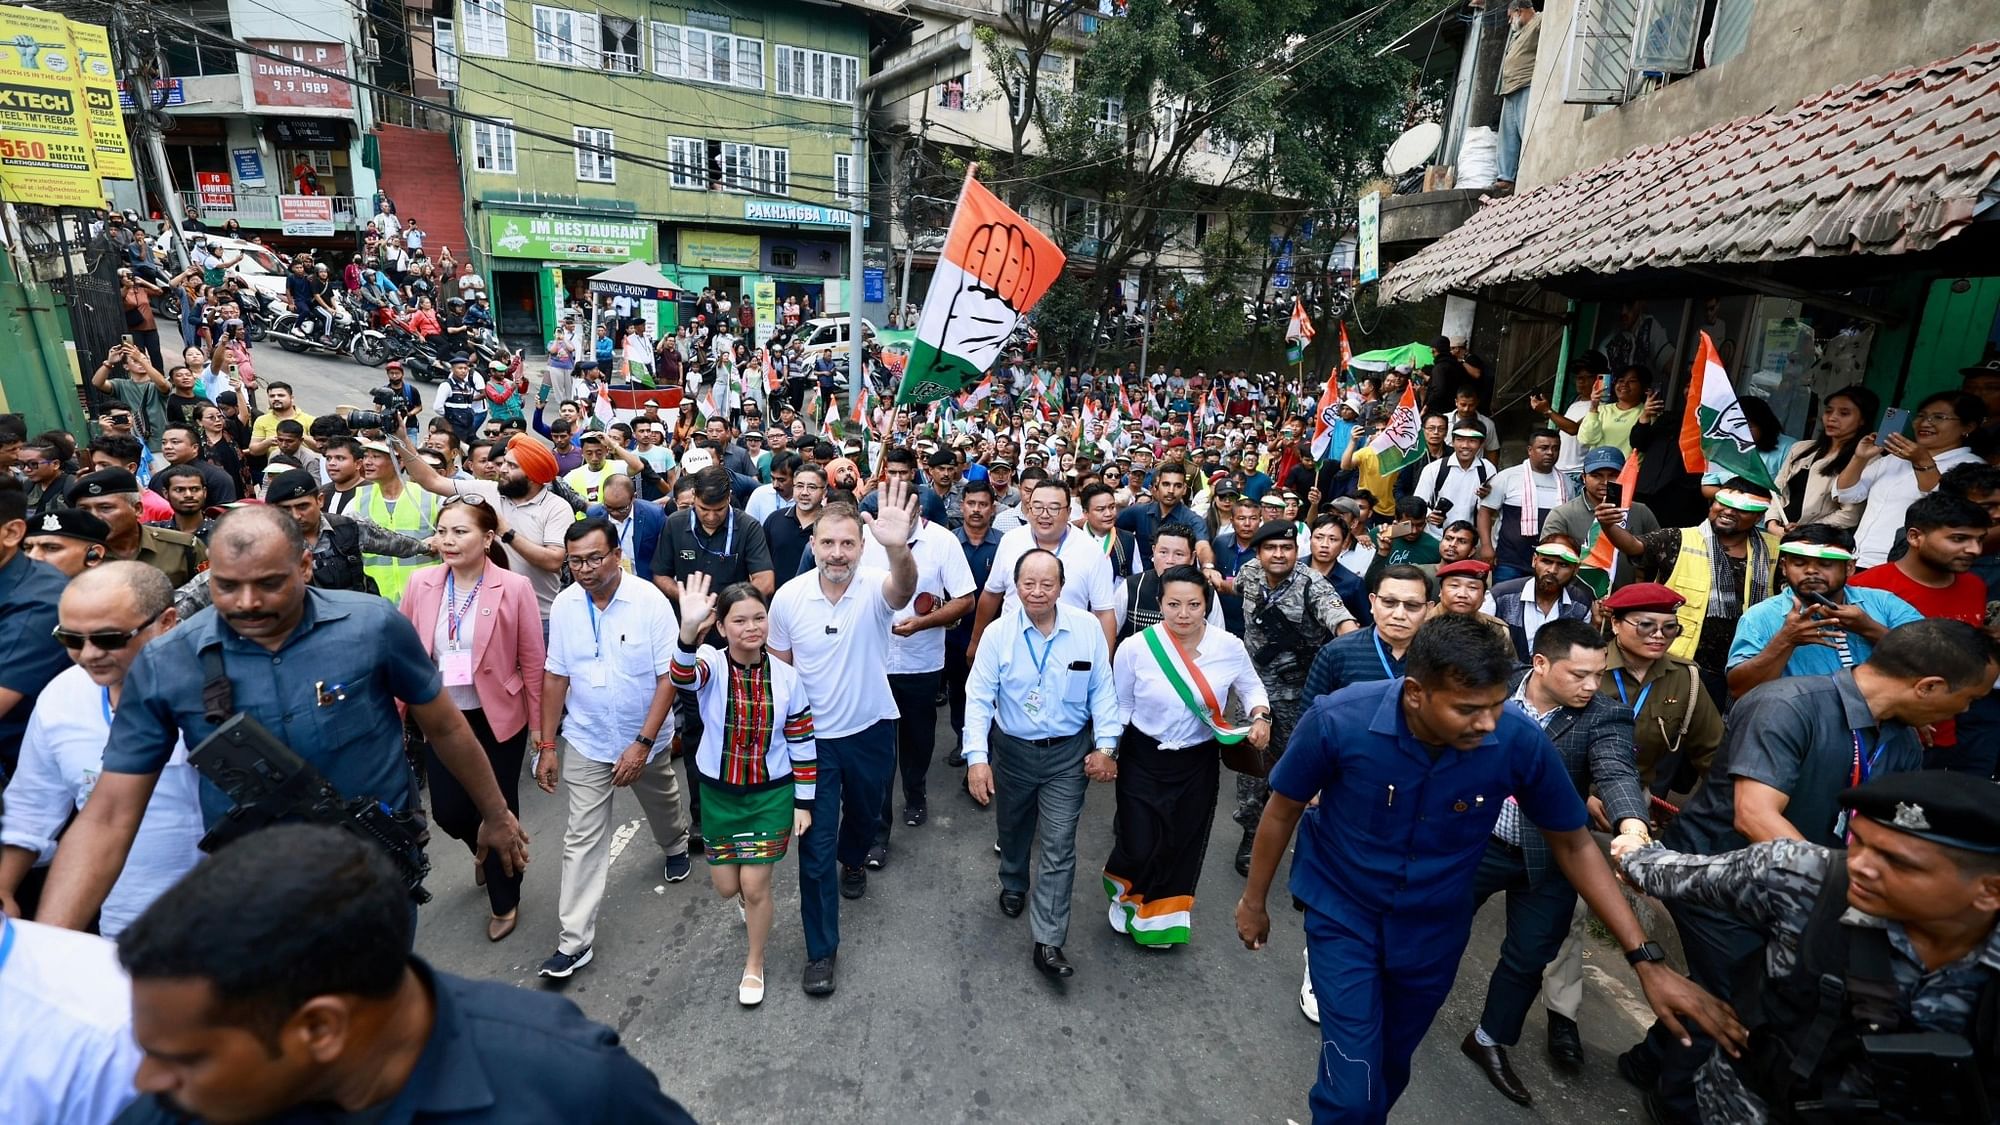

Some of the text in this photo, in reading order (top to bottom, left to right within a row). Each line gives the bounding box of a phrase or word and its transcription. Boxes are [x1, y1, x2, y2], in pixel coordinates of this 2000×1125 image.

[23, 112, 42, 123] TMT
[44, 115, 76, 125] REBAR
[0, 139, 45, 159] 550
[47, 143, 85, 153] SUPER
[49, 153, 86, 162] DUCTILE
[202, 184, 232, 193] COUNTER
[748, 203, 822, 222] PAKHANGBA
[530, 220, 550, 235] JM
[554, 222, 648, 240] RESTAURANT
[625, 285, 648, 296] POINT
